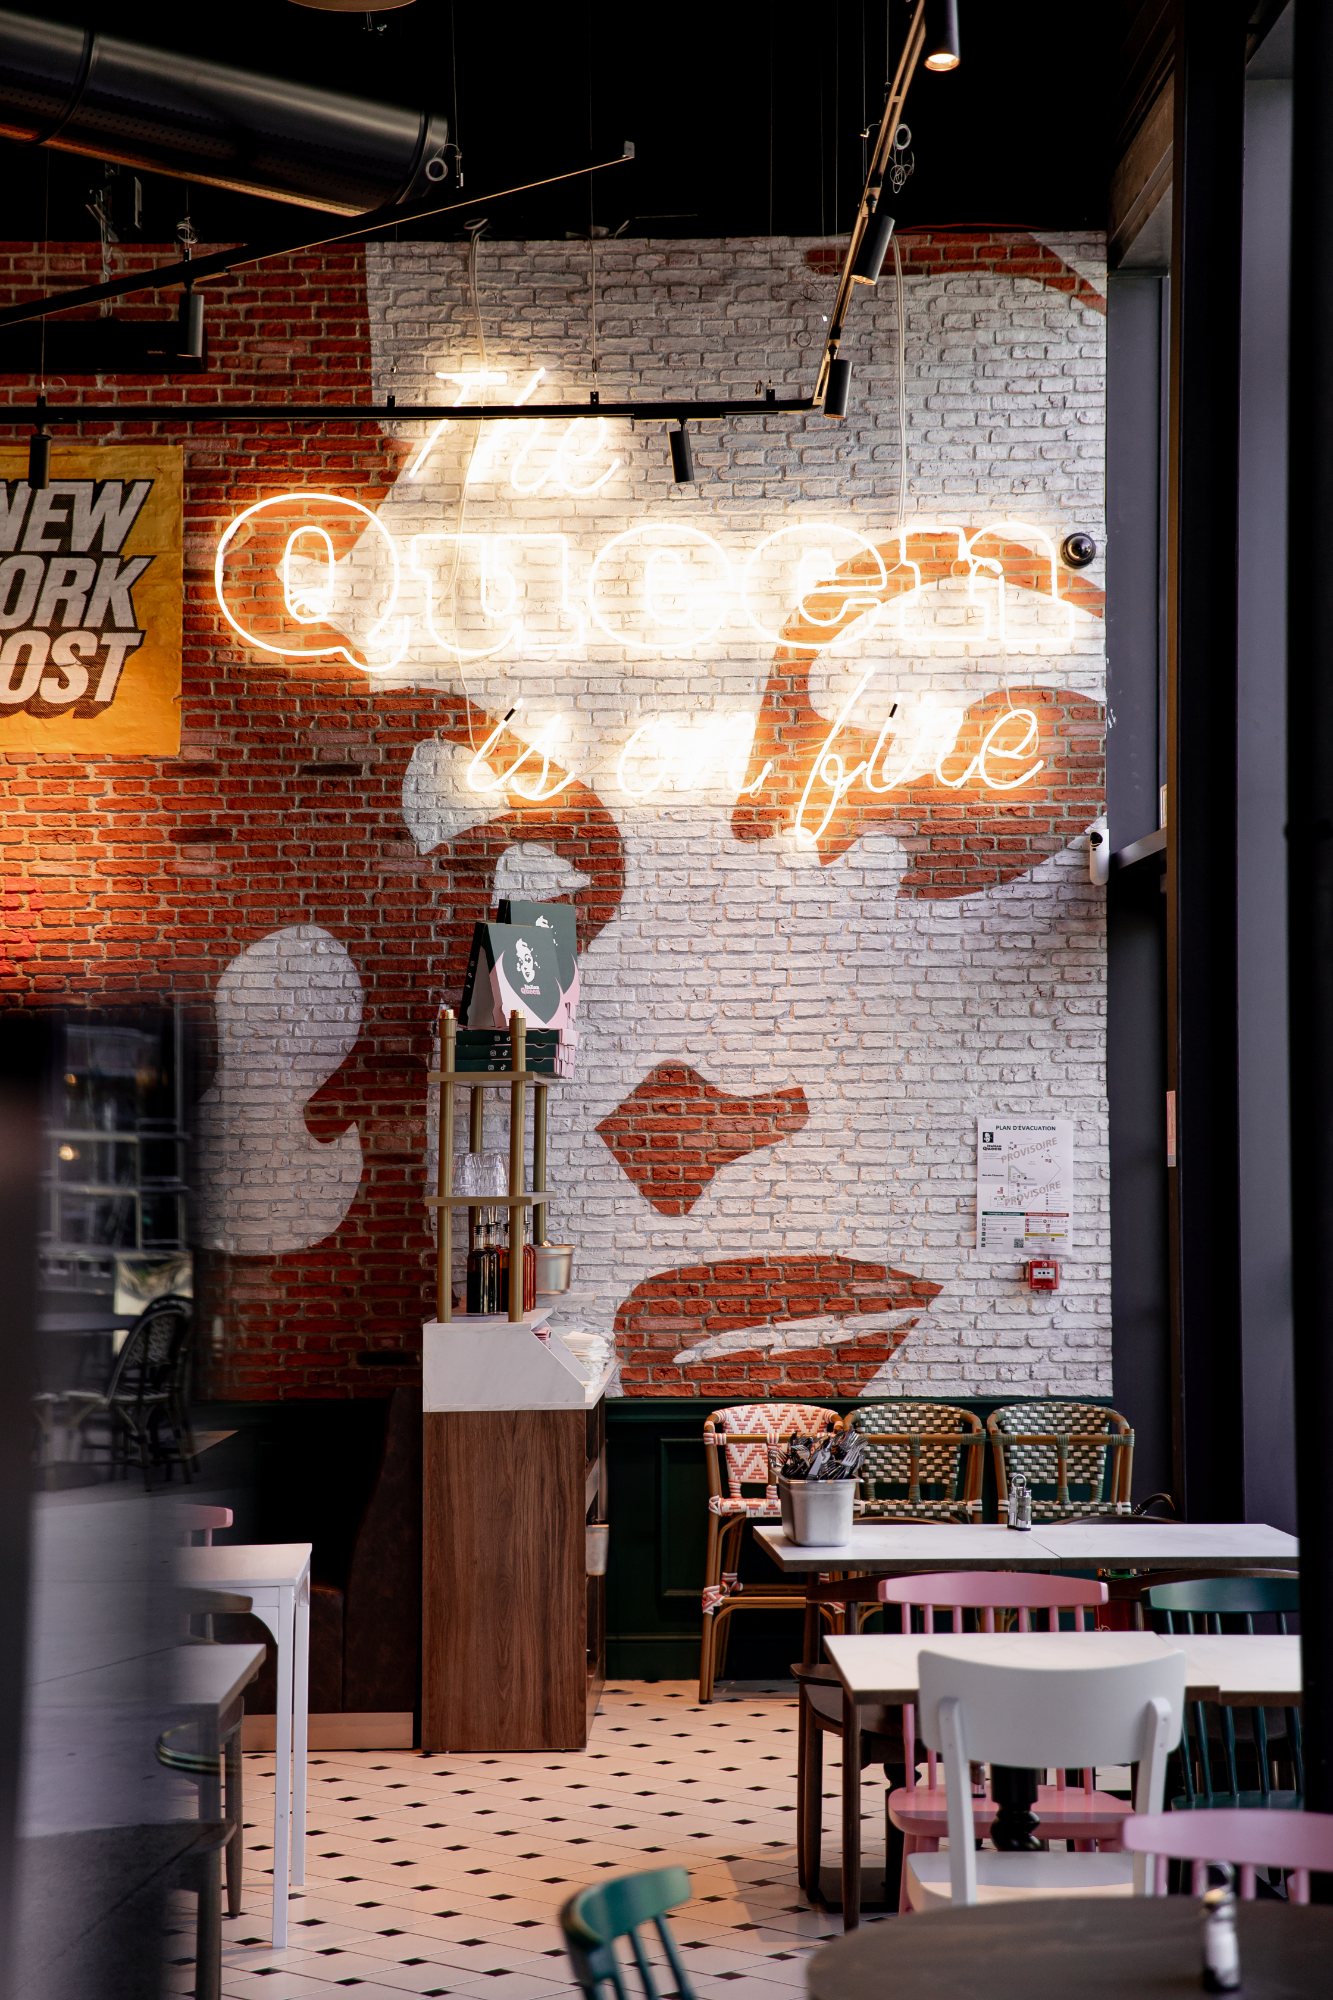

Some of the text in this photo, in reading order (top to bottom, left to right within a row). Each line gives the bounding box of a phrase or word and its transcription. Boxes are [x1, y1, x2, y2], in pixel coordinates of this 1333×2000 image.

[409, 366, 621, 494] The
[0, 553, 153, 630] ORK
[215, 492, 1076, 673] Queen
[0, 630, 144, 704] OST
[465, 665, 1045, 845] is on fire
[1001, 1137, 1058, 1164] PROVISOIRE
[1005, 1181, 1061, 1206] PROVISOIRE
